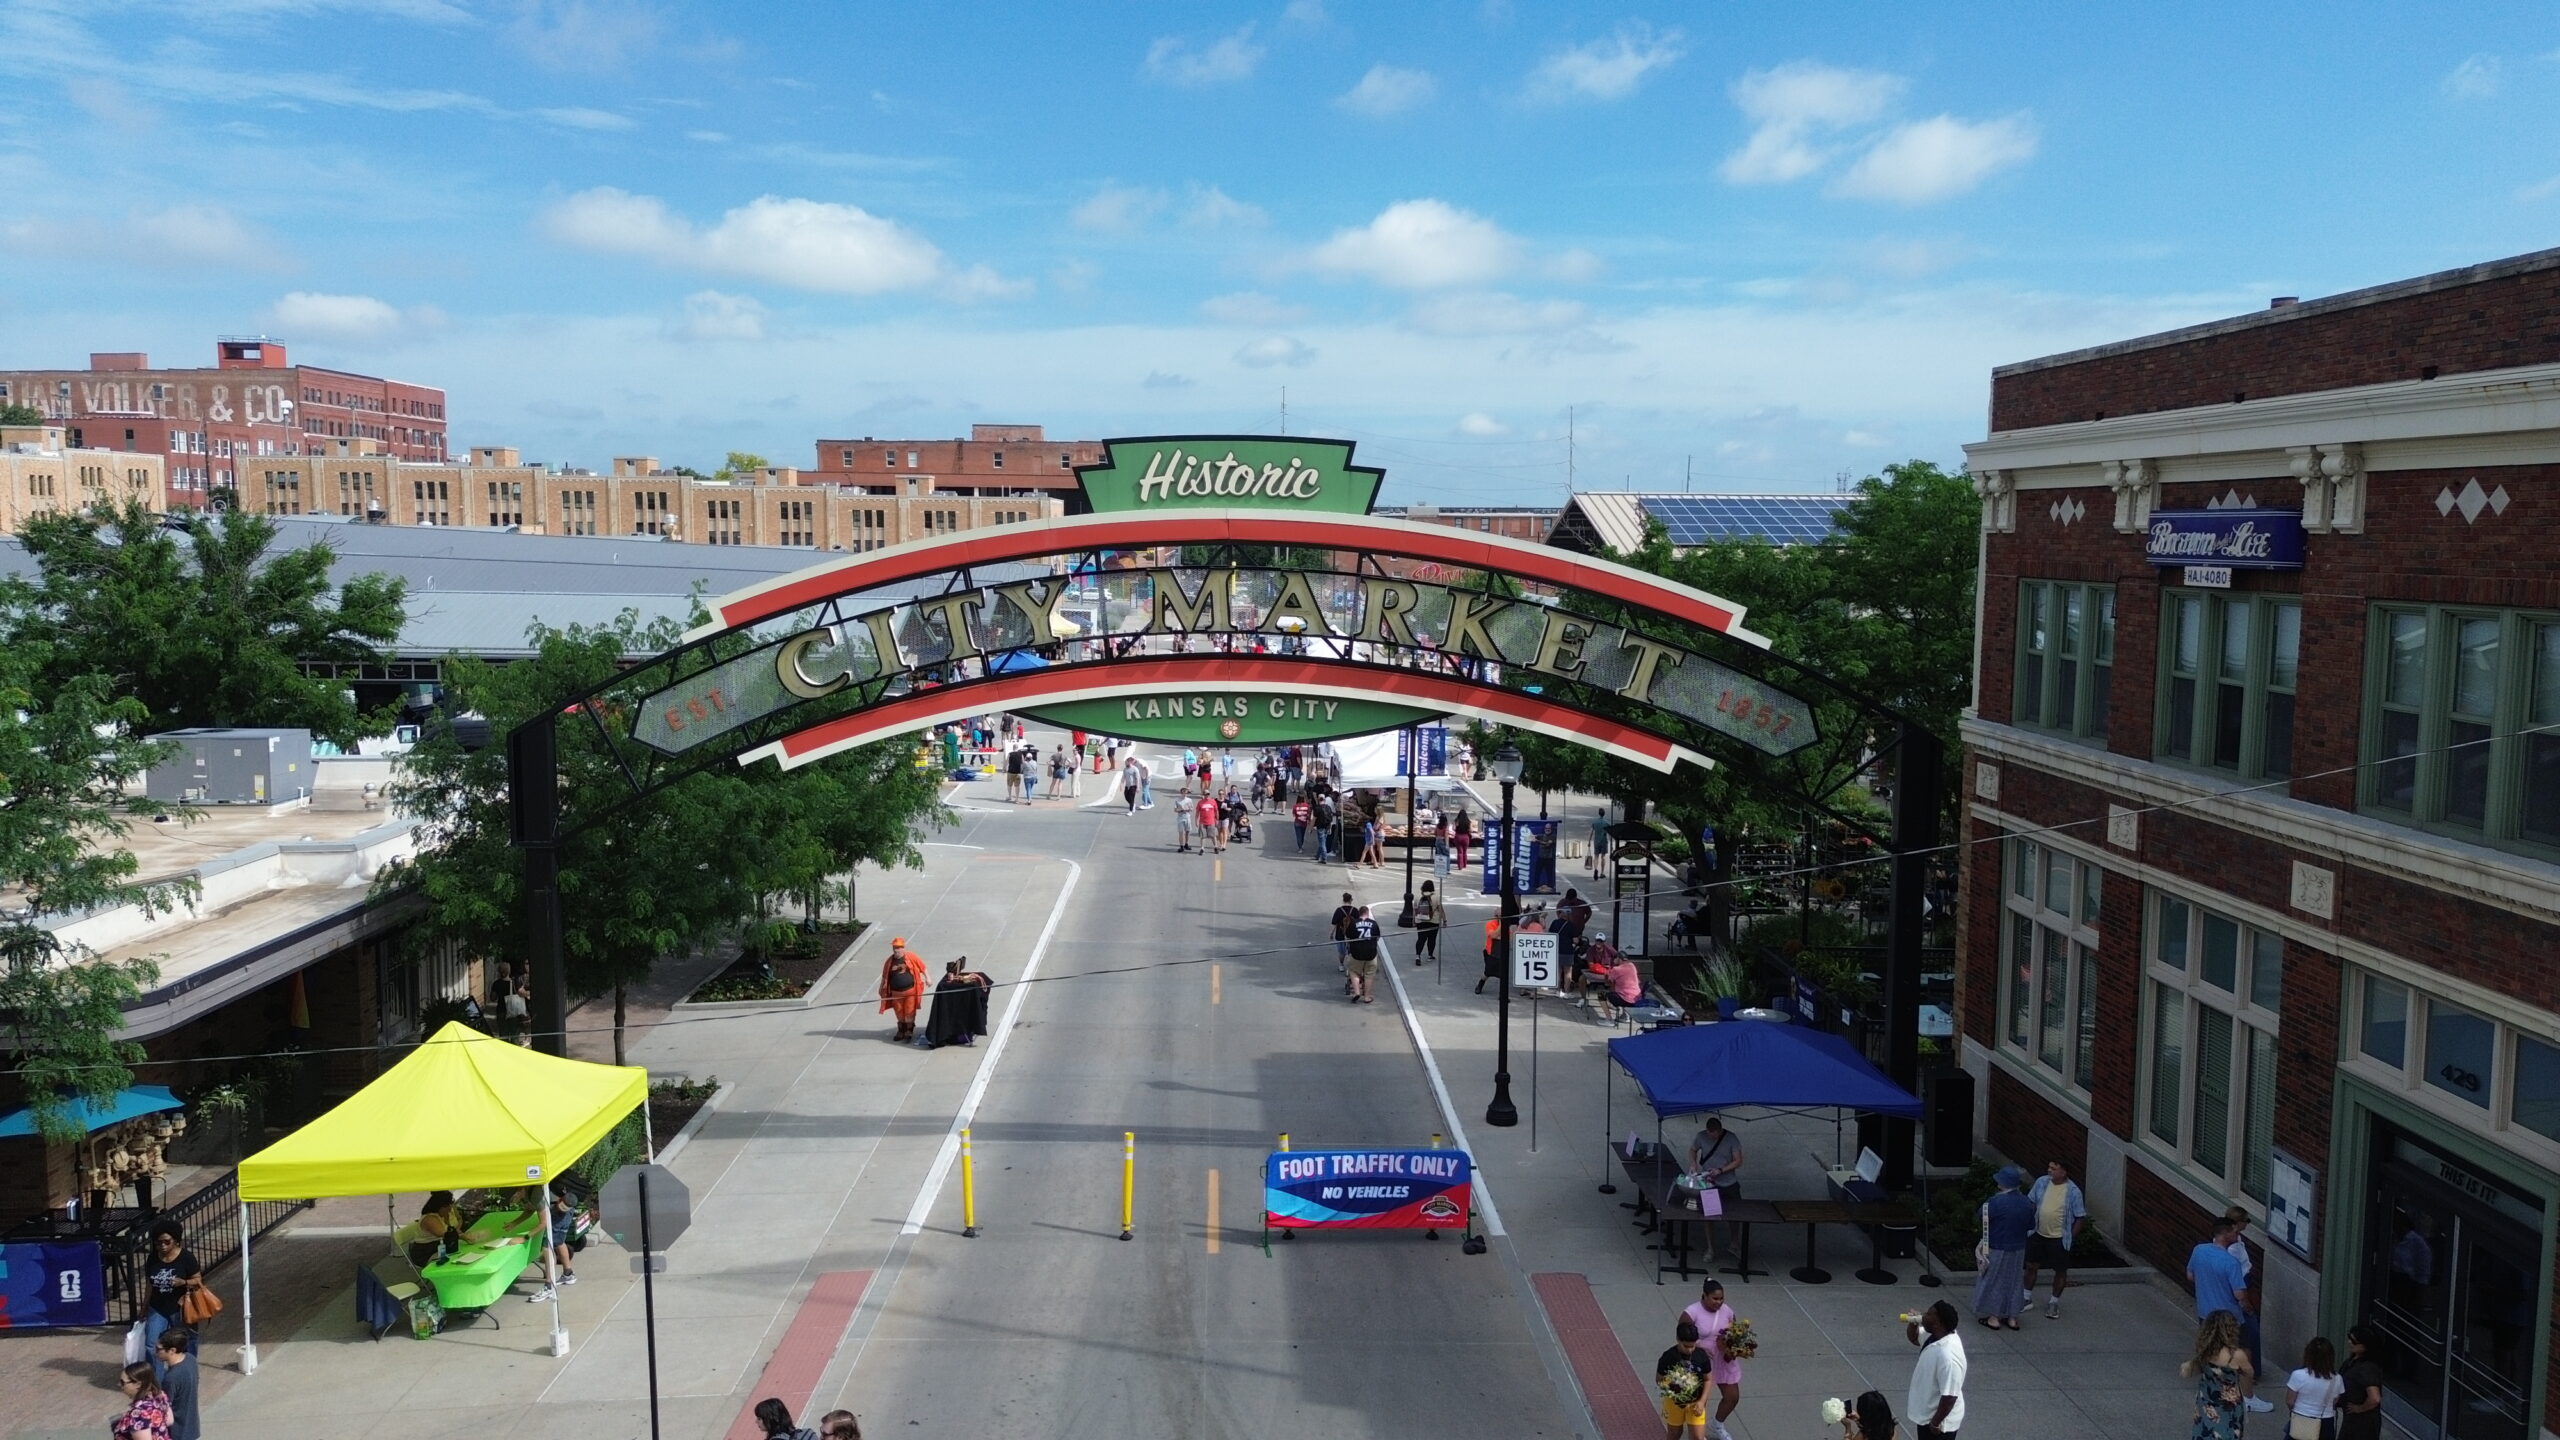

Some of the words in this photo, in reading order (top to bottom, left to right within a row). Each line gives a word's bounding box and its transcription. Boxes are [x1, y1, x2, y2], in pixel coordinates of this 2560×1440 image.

[208, 384, 234, 422] &
[1139, 448, 1321, 502] Historic
[774, 573, 1072, 700] CITY
[1147, 566, 1688, 706] MARKET
[1125, 696, 1249, 721] KANSAS
[1269, 697, 1340, 722] CITY
[1716, 687, 1793, 735] 1857
[1418, 728, 1430, 776] welcome
[1488, 827, 1499, 838] OF
[1487, 839, 1498, 868] WORLD
[1514, 824, 1532, 891] culture
[1357, 928, 1371, 939] 74
[1518, 939, 1555, 949] SPEED
[1522, 950, 1550, 959] LIMIT
[1523, 961, 1549, 981] 15
[2441, 1064, 2478, 1093] 429
[1279, 1156, 1325, 1180] FOOT
[1331, 1154, 1405, 1175] TRAFFIC
[1410, 1155, 1459, 1177] ONLY
[1322, 1186, 1342, 1199] NO
[1347, 1185, 1410, 1199] VEHICLES
[2440, 1162, 2465, 1186] THIS
[2466, 1177, 2479, 1194] IS
[2479, 1184, 2497, 1205] IT!
